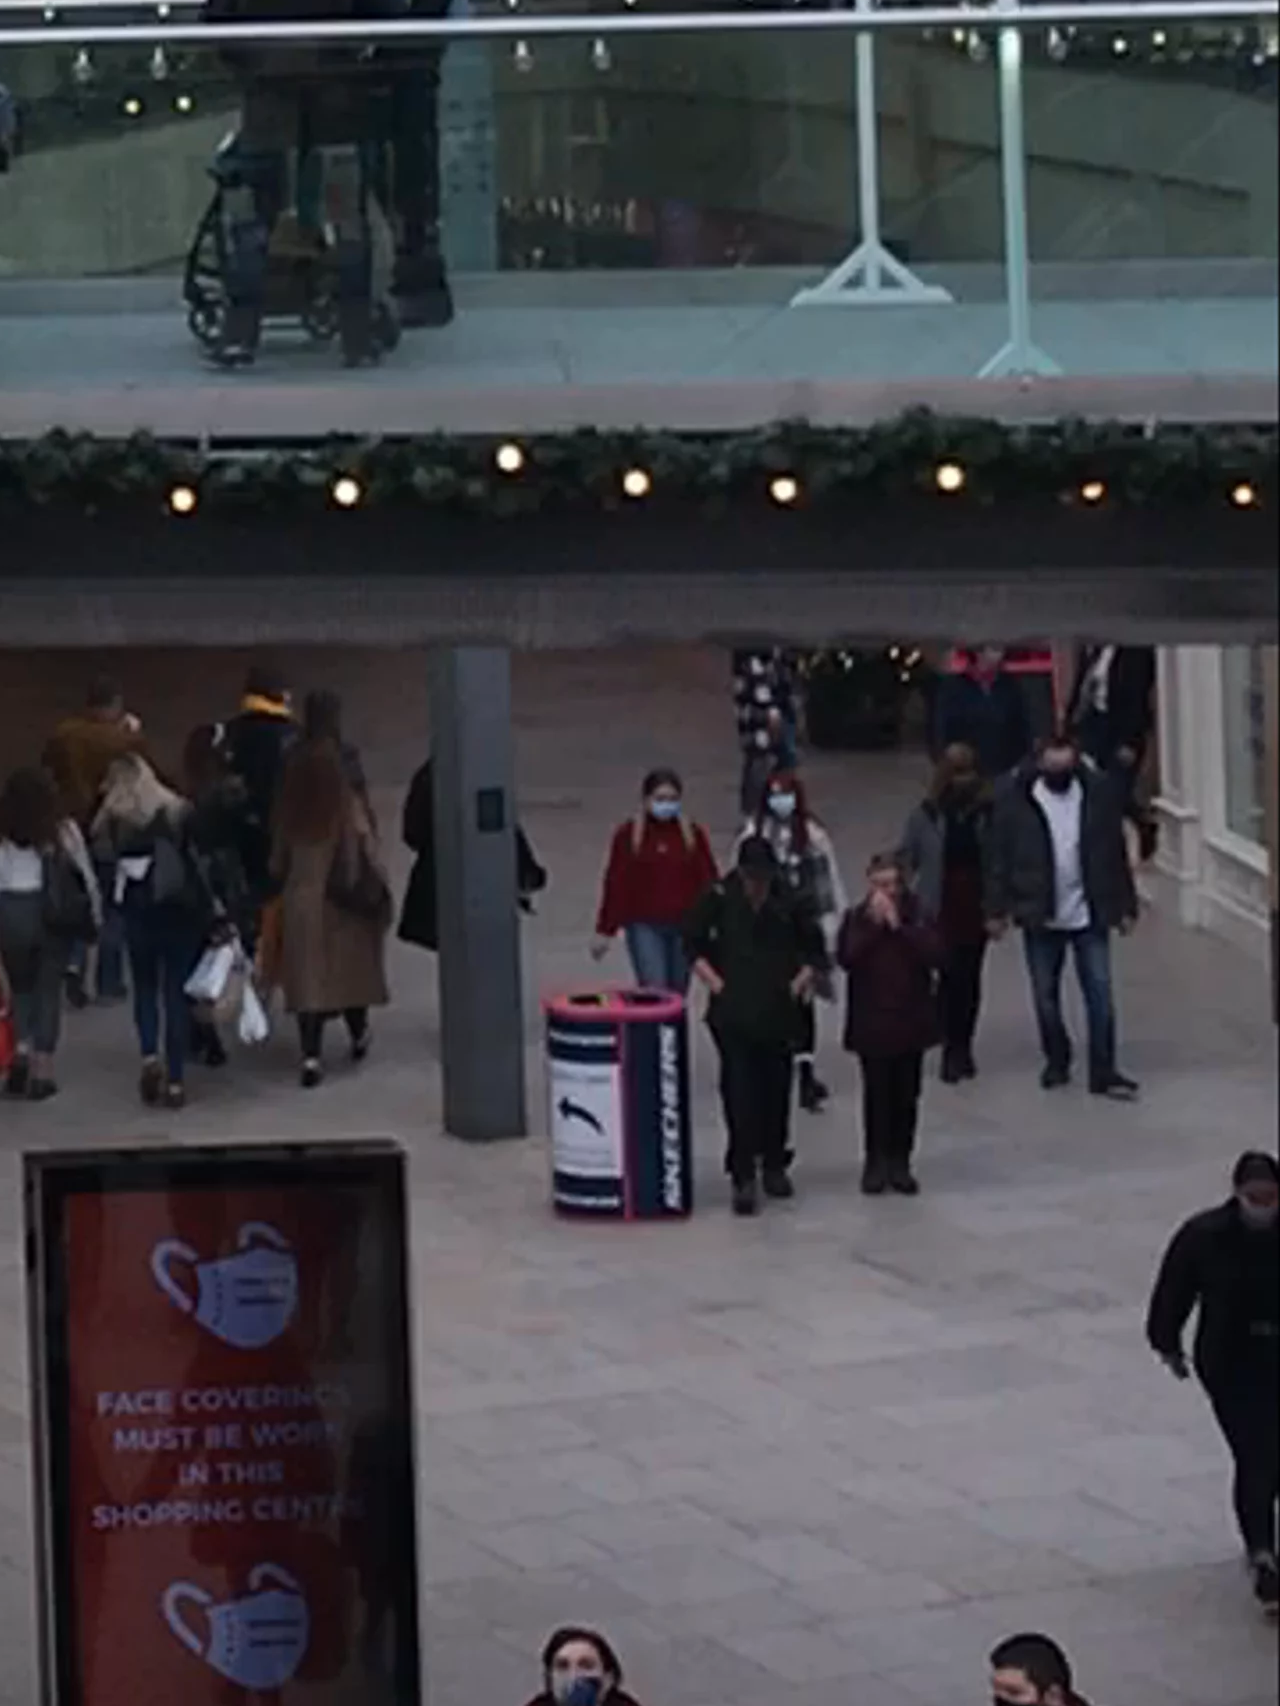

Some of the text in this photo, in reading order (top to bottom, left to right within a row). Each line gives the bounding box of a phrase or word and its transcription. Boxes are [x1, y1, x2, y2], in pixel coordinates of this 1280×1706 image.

[659, 1023, 683, 1210] SKECHERS
[96, 1390, 174, 1417] FACE
[112, 1426, 195, 1452] MUST
[204, 1423, 242, 1449] BE
[178, 1460, 284, 1486] IN THIS
[92, 1497, 245, 1529] SHOPPING
